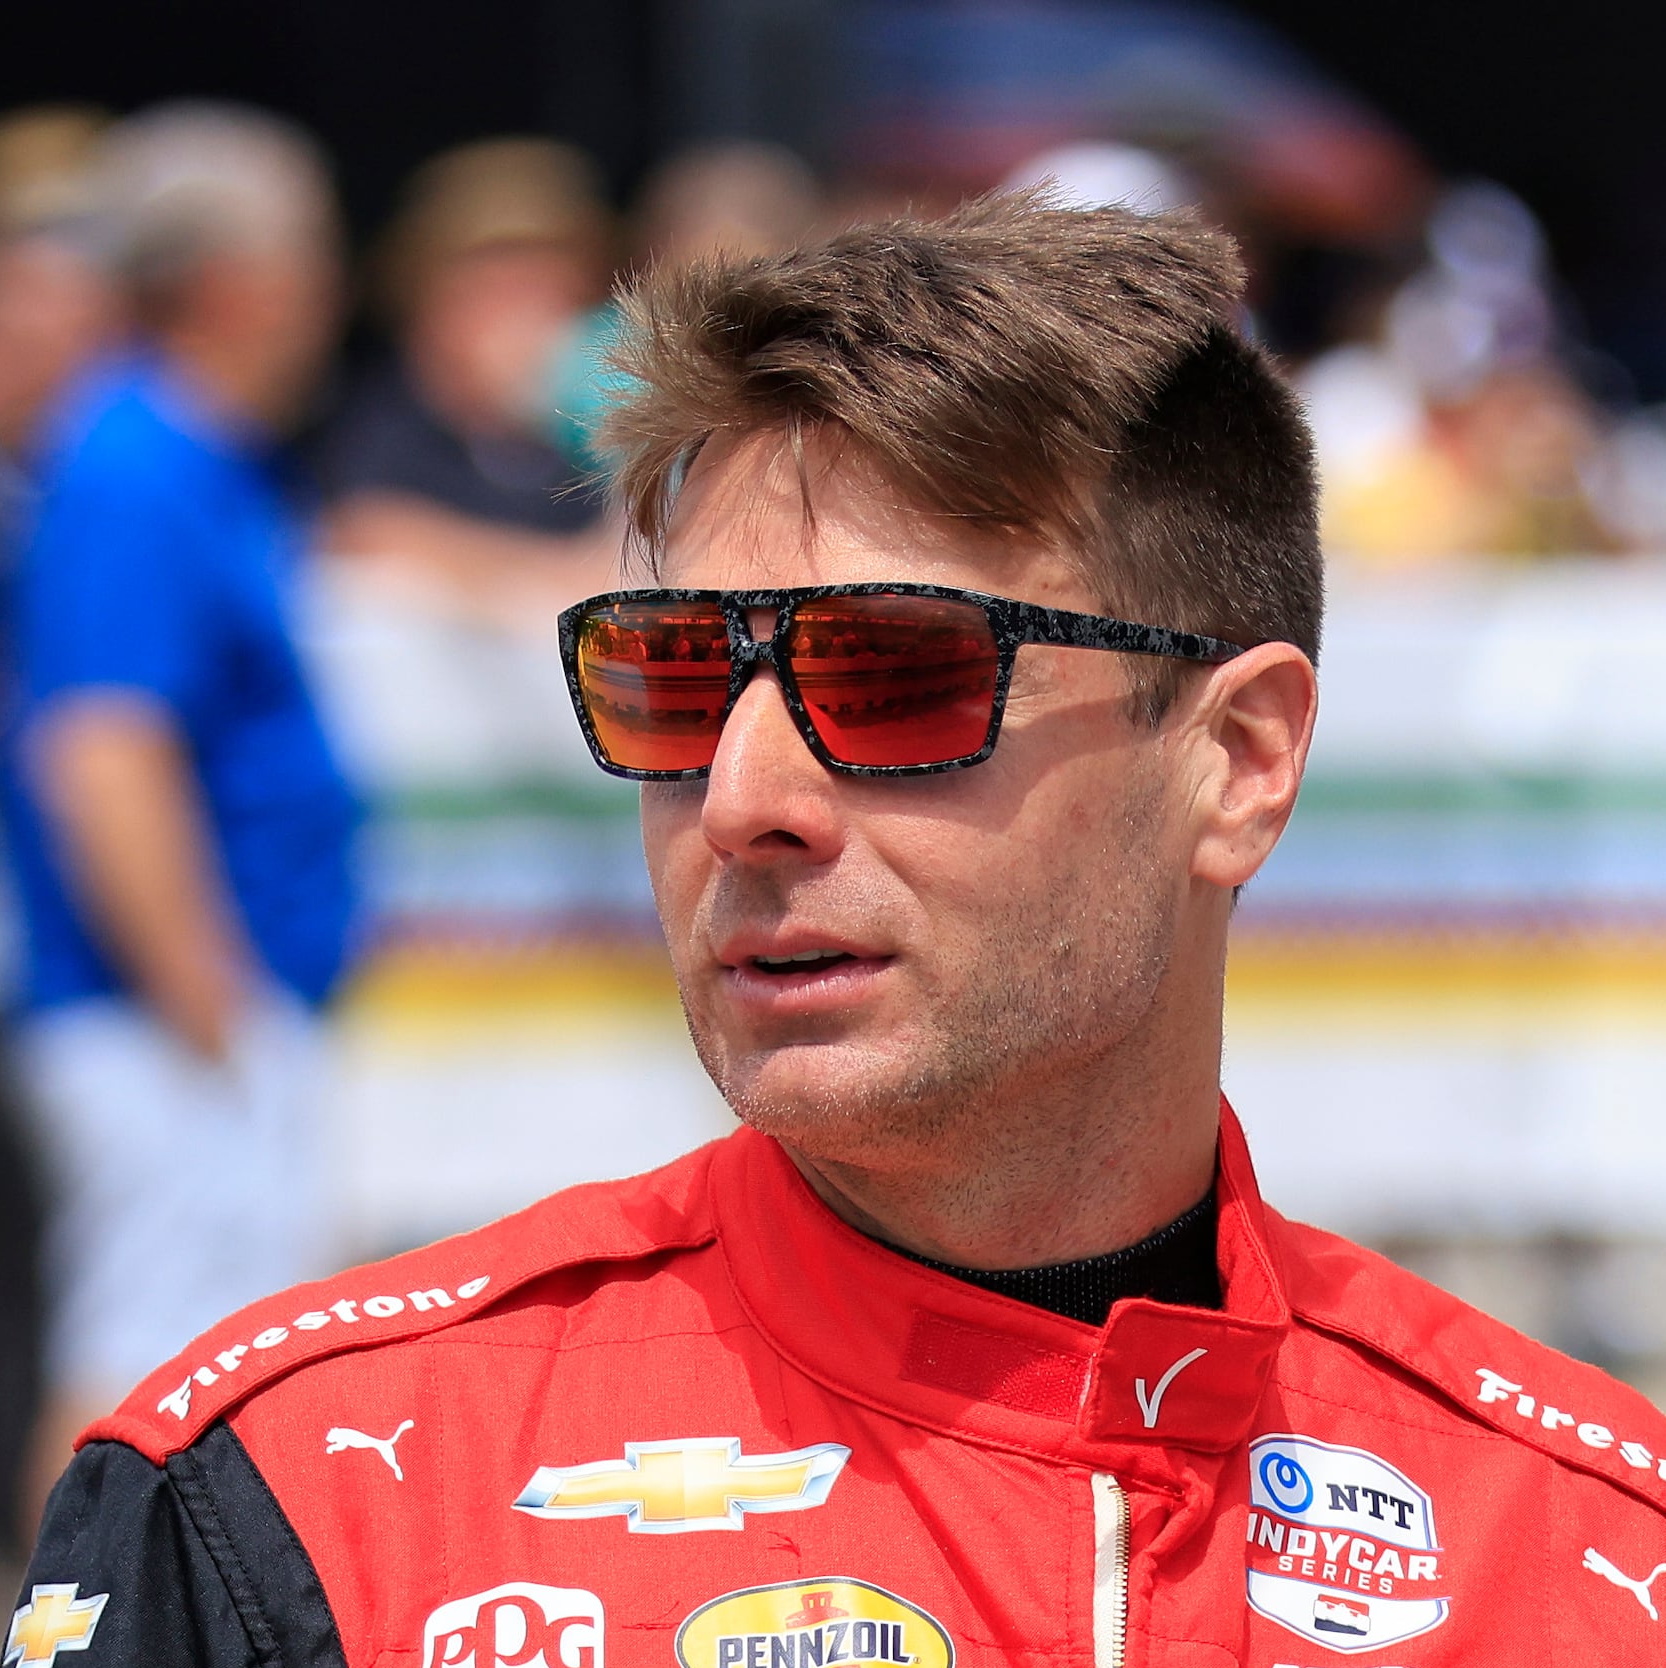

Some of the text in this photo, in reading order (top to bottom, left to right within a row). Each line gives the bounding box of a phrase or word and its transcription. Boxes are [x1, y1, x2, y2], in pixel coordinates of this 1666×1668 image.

[156, 1275, 491, 1421] Firestone
[1326, 1483, 1414, 1530] NTT
[1247, 1512, 1438, 1581] INDYCAR
[1278, 1555, 1394, 1595] SERIES
